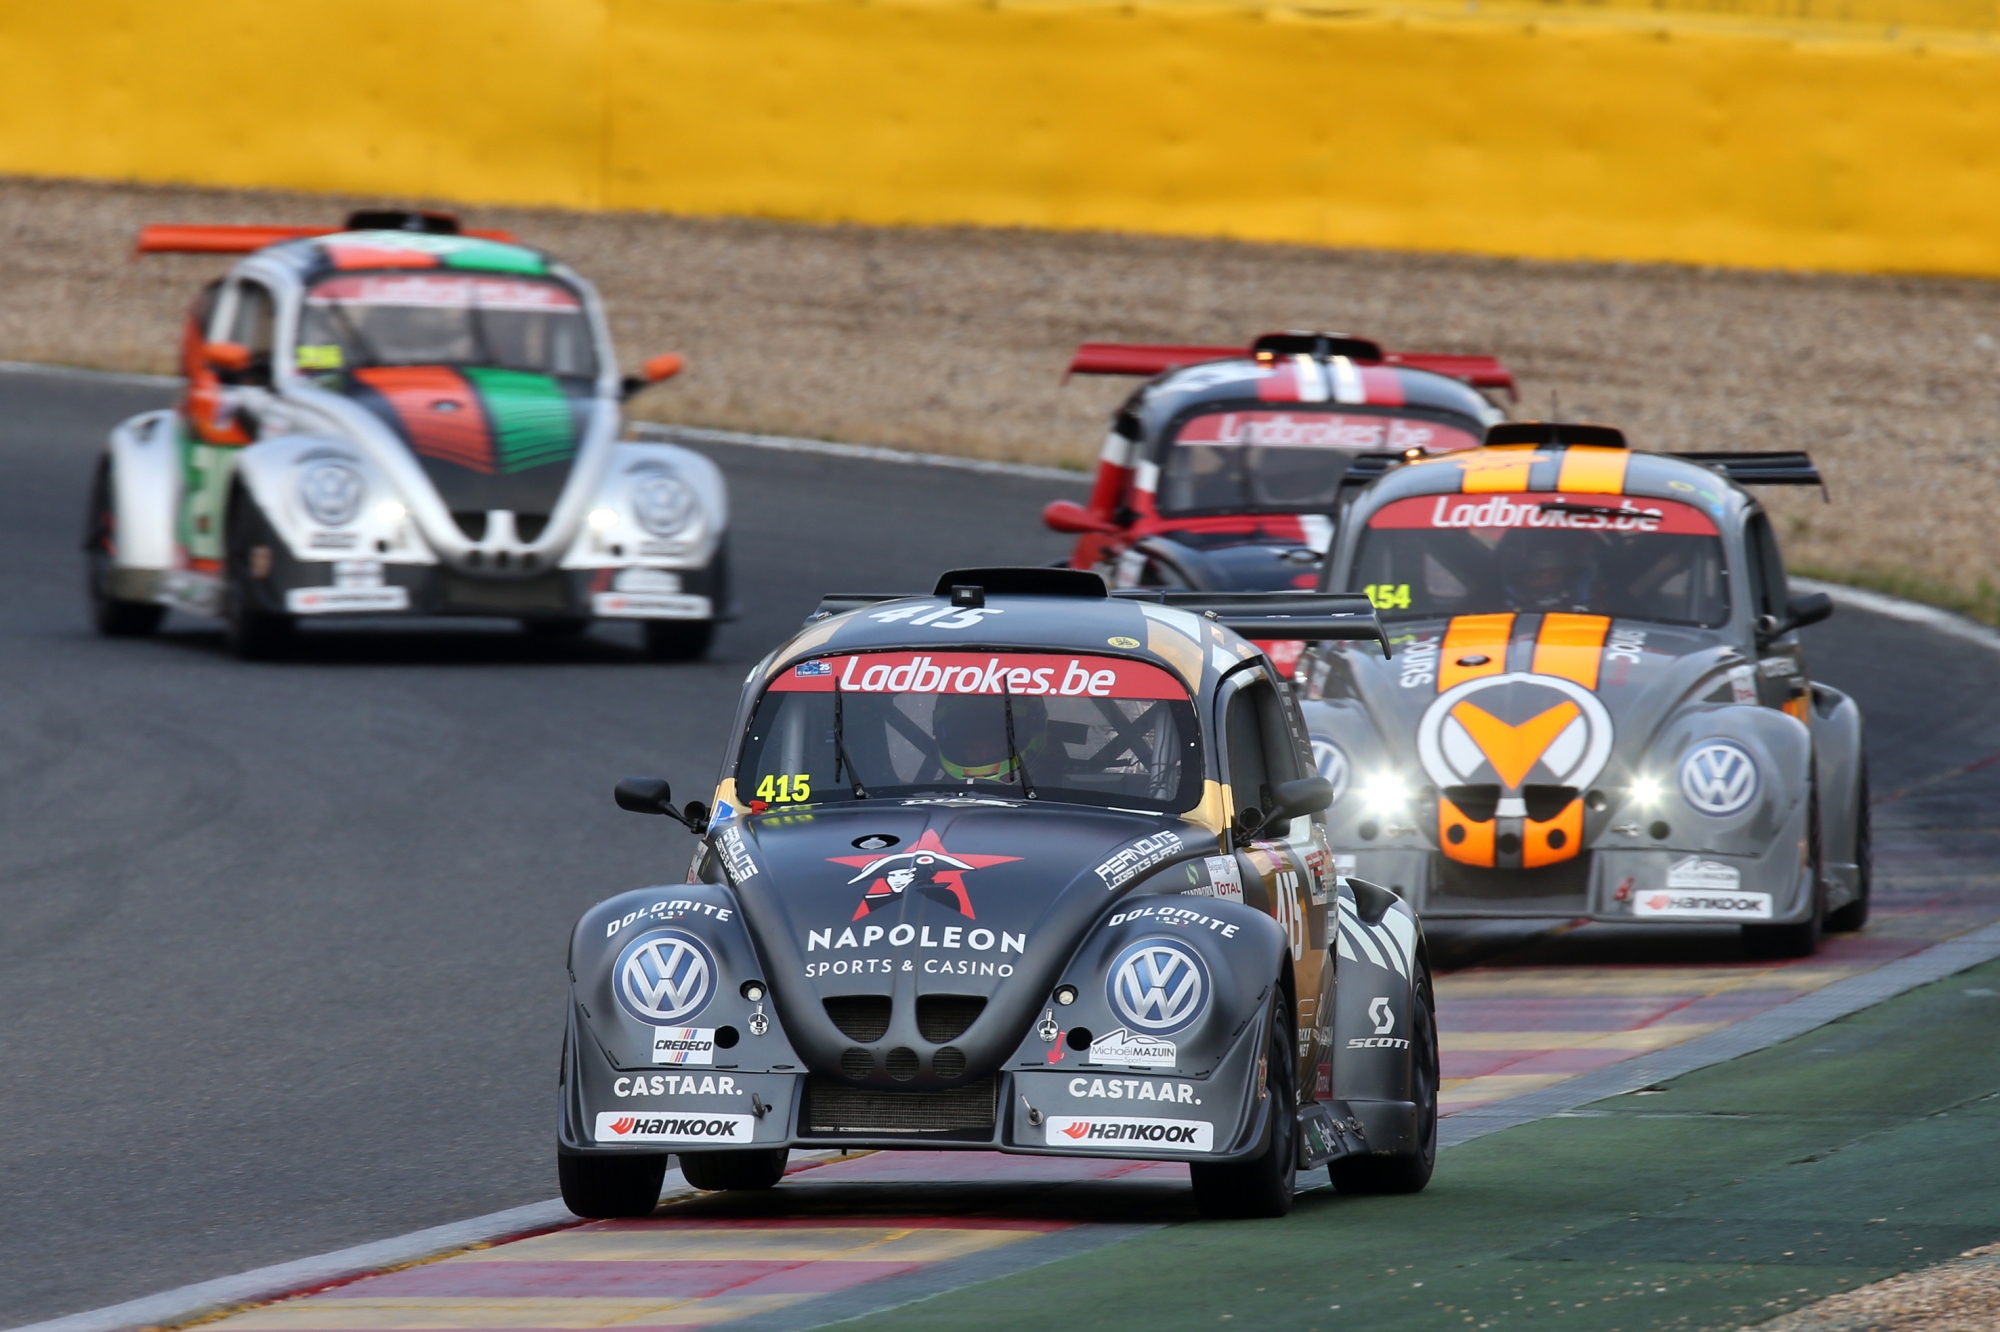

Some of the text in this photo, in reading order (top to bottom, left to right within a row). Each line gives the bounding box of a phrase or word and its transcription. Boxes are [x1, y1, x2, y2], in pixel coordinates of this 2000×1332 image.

[1217, 412, 1435, 447] Ladbrokesbe
[1364, 584, 1411, 609] 154
[868, 605, 1005, 629] 415
[839, 655, 1116, 696] Ladbrokes.be
[756, 774, 811, 803] 415
[1105, 841, 1184, 890] LOGISTICS SUPPORT
[1214, 881, 1241, 896] TOTAL
[607, 900, 733, 938] DOLOMITE
[650, 911, 684, 919] 1897
[1108, 906, 1240, 939] DOLOMITE
[1154, 916, 1190, 925] 1897
[807, 923, 1026, 954] NAPOLEON
[805, 959, 1014, 978] SPORTS & CASINO
[655, 1039, 713, 1052] CREDECO
[1346, 1037, 1410, 1050] SCOTT
[1123, 1056, 1142, 1064] Sport
[614, 1076, 743, 1098] CASTAAR.
[1068, 1077, 1202, 1105] CASTAAR.
